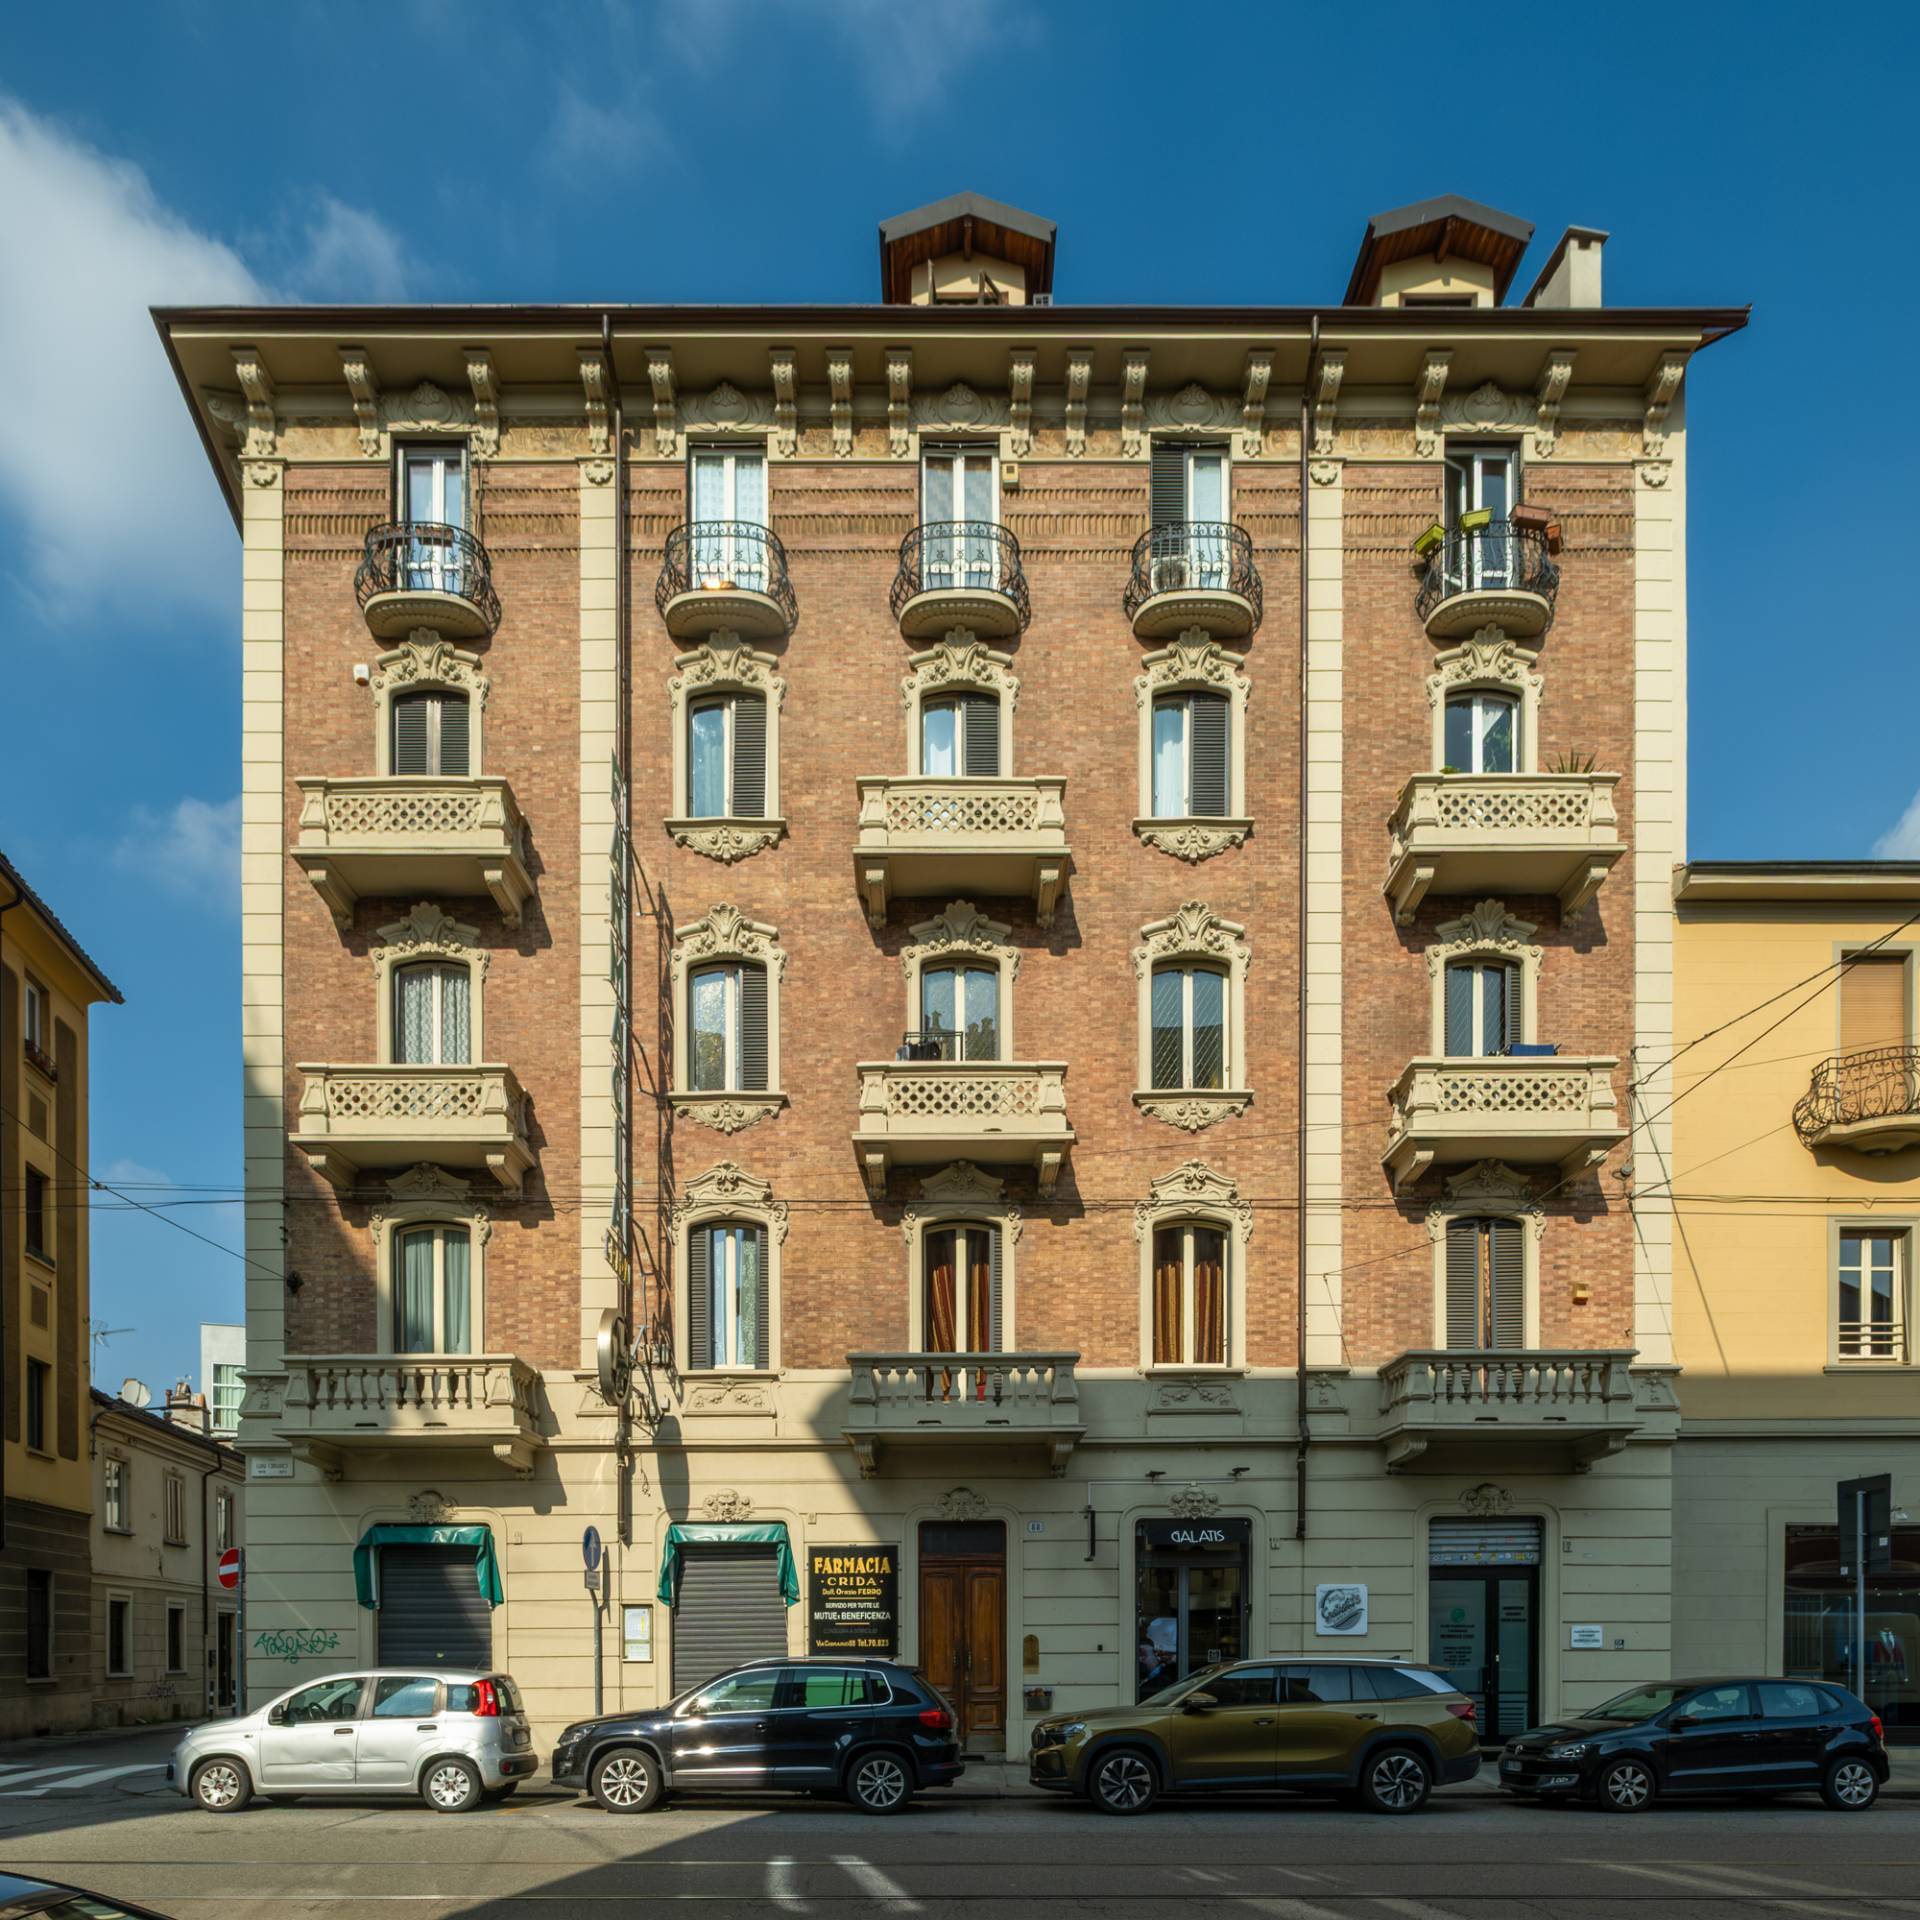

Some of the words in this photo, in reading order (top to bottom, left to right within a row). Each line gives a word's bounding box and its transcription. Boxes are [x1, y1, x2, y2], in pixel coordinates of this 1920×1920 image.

[1170, 1529, 1225, 1543] GALATIS
[814, 1557, 891, 1574] FARMACIA
[827, 1577, 877, 1586] CRIDA
[814, 1612, 837, 1620] MUTUE
[841, 1612, 891, 1620] BENEFICENZA
